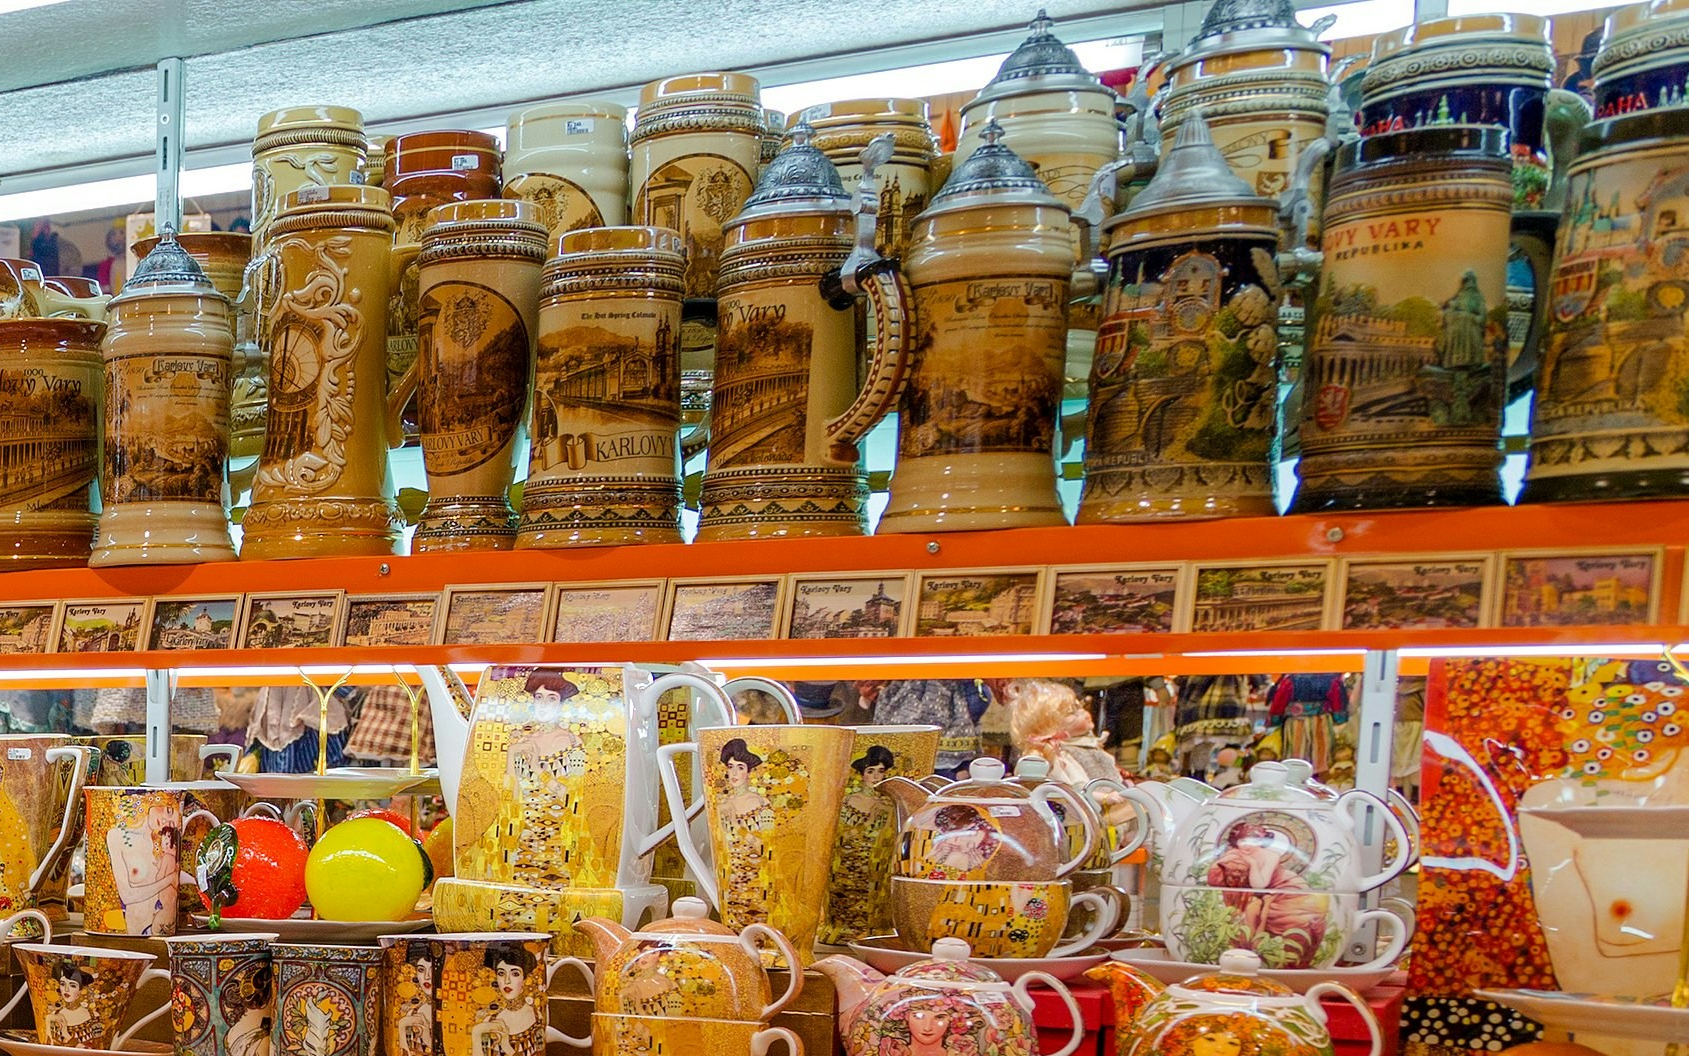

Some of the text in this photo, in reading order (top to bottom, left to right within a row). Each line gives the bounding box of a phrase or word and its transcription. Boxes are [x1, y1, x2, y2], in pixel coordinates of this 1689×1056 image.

[1367, 217, 1443, 241] VARY
[1335, 240, 1425, 262] REPUBLIKA
[42, 375, 83, 397] Vary
[596, 434, 668, 462] KARLOVY
